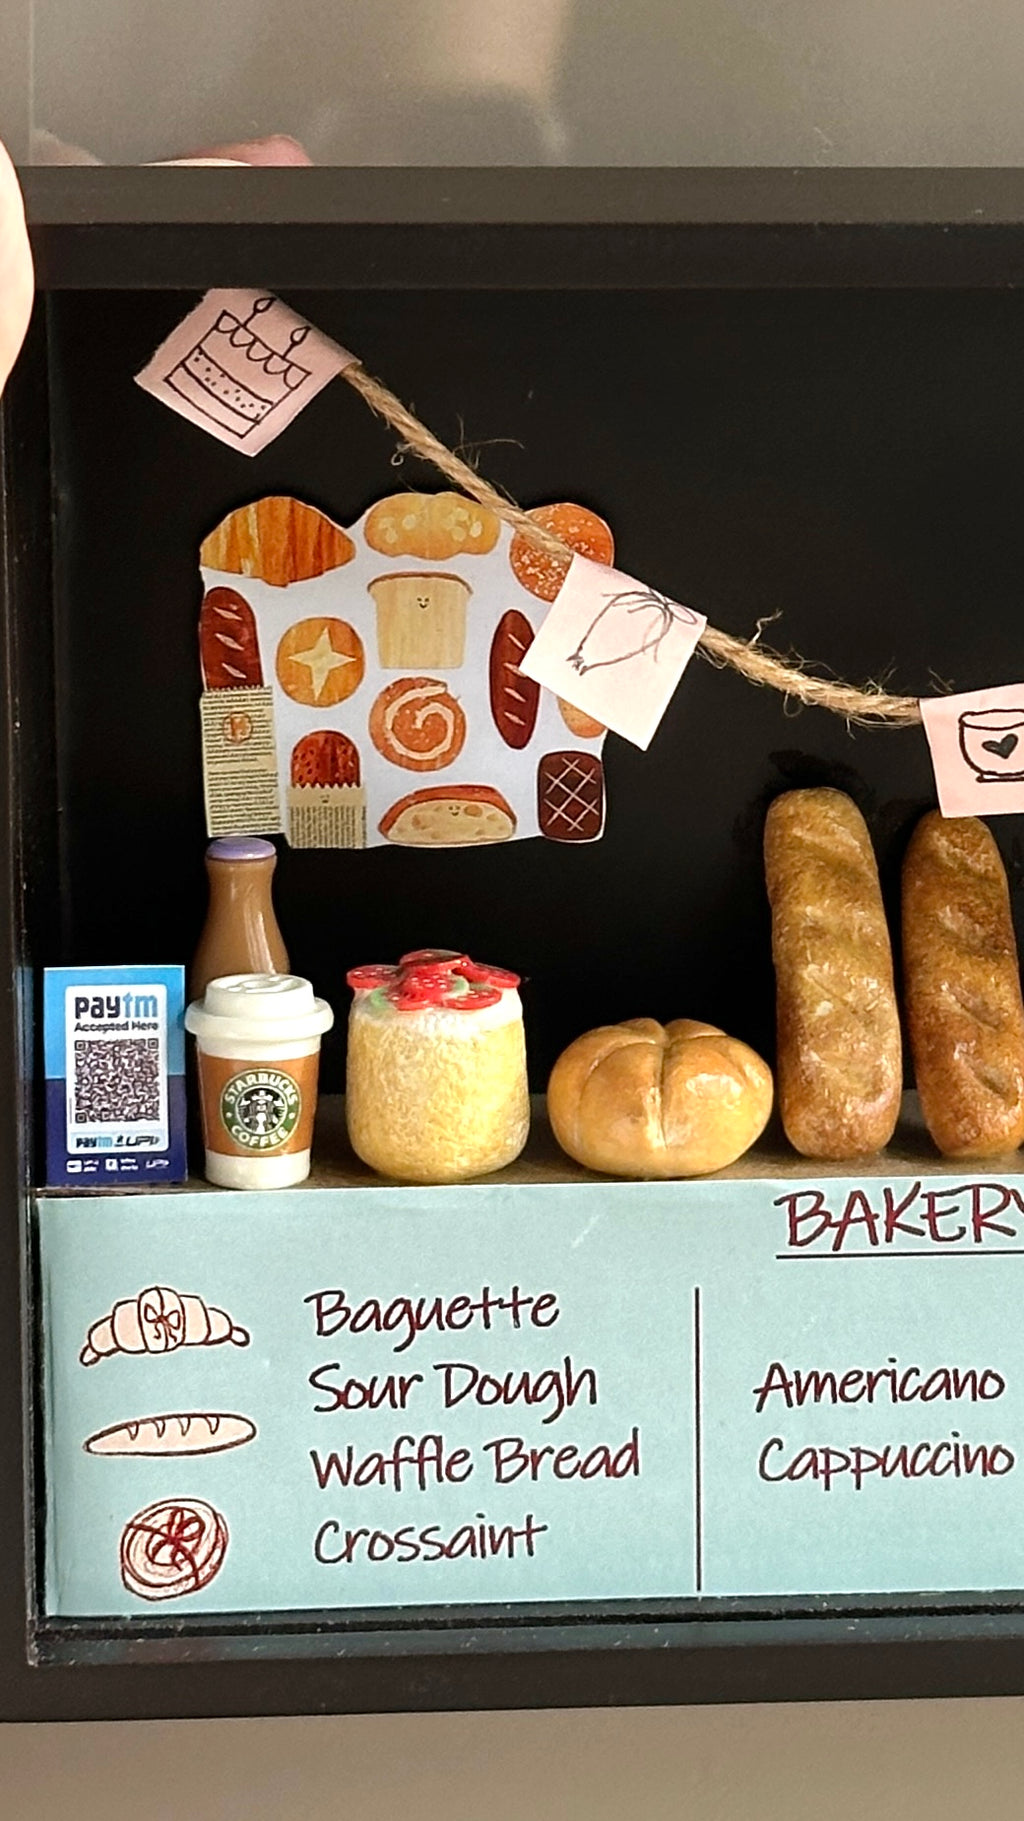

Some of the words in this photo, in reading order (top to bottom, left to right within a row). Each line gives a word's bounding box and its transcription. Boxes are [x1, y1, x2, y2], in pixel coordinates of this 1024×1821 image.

[74, 992, 158, 1019] paytm
[74, 1021, 129, 1034] Accepted
[131, 1021, 159, 1031] Here
[224, 1072, 298, 1106] STARBUCKS
[231, 1124, 289, 1147] COFFEE
[773, 1181, 1024, 1251] BAKER
[303, 1286, 560, 1352] Baguette
[308, 1363, 424, 1412] Sour
[432, 1356, 597, 1424] Dough
[752, 1357, 1006, 1413] Americano
[309, 1435, 474, 1491] Waffle
[482, 1426, 640, 1483] Bread
[759, 1431, 1015, 1491] Cappuccino
[314, 1513, 548, 1564] Crossaint
